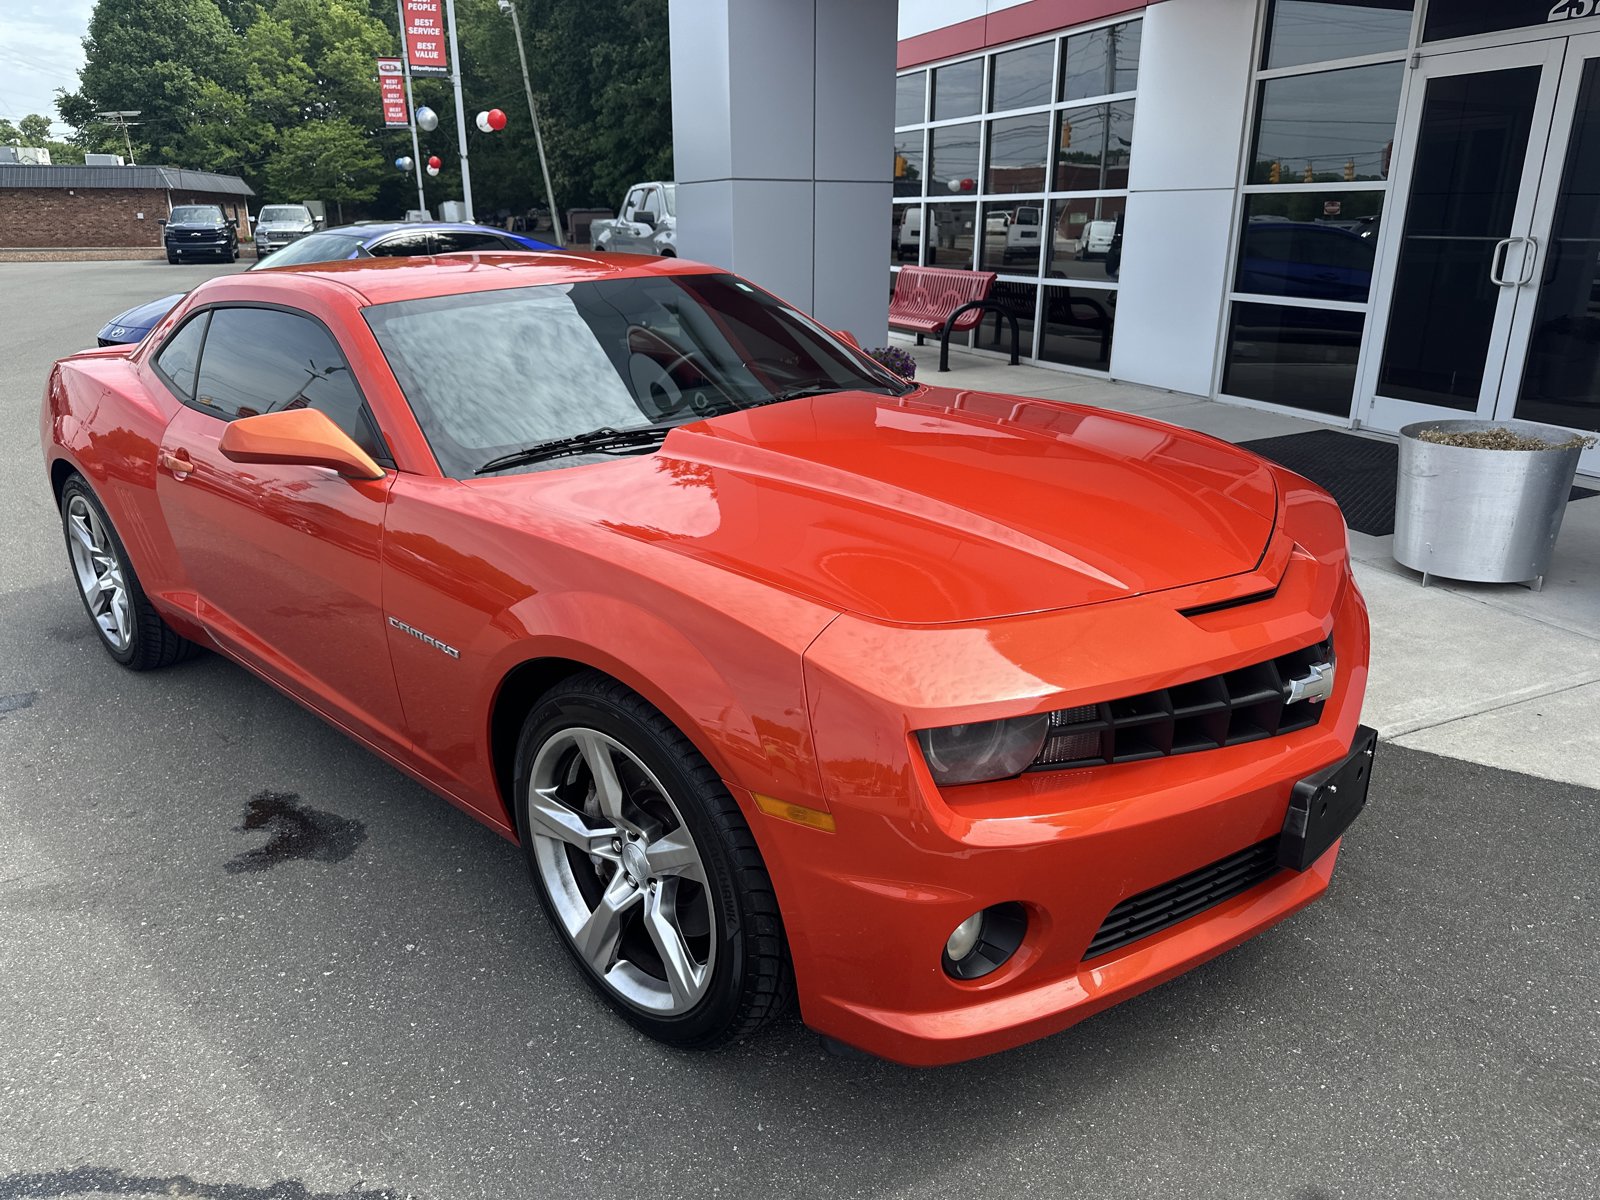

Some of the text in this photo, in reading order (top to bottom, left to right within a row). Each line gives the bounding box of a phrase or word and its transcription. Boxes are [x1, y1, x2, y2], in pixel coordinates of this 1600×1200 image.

[408, 3, 437, 11] PEOPLE
[1547, 0, 1600, 21] 23
[414, 18, 434, 26] BEST
[408, 27, 440, 35] SERVICE
[415, 50, 439, 58] VALUE
[389, 616, 460, 659] CAMARO
[702, 827, 738, 923] ACKHAWK
